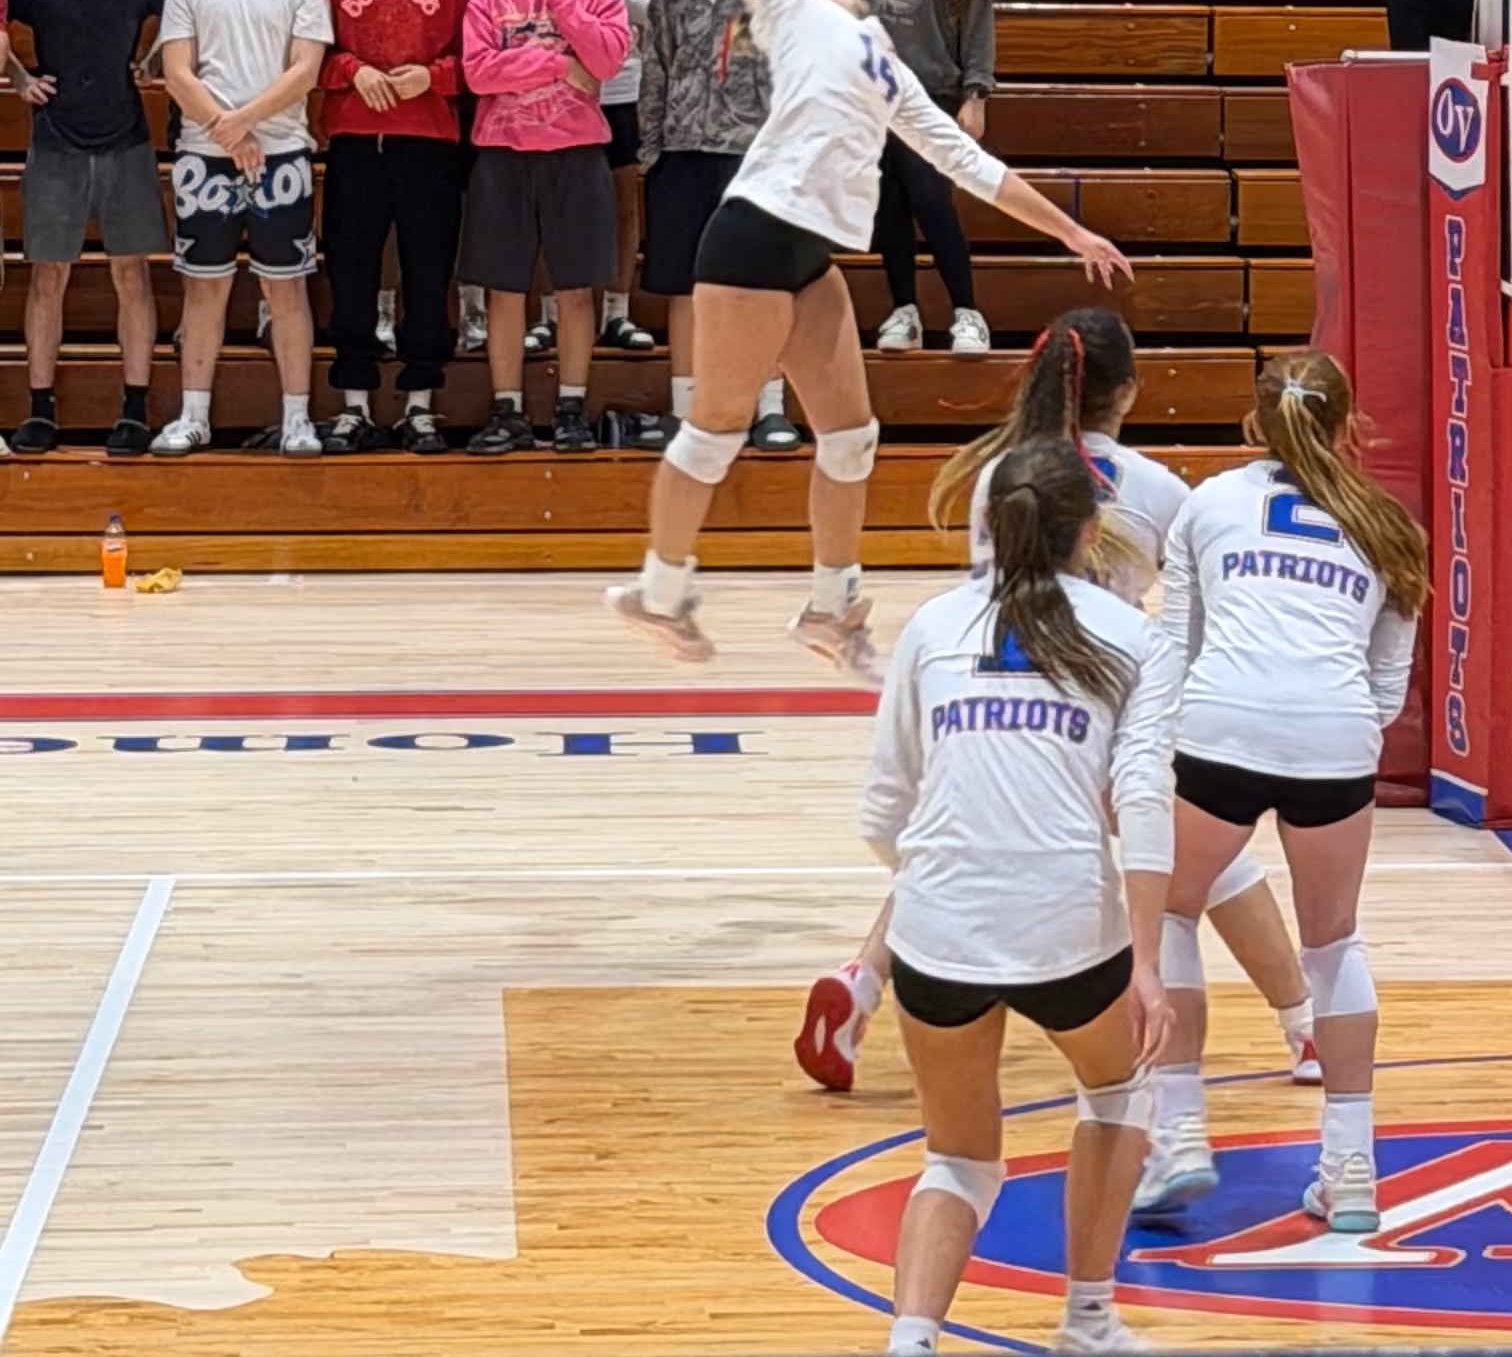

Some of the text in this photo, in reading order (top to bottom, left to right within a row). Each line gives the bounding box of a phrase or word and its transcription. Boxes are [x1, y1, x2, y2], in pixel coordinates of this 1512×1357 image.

[1437, 87, 1475, 155] OV
[1443, 213, 1472, 758] PATRIOTS
[1221, 549, 1370, 604] PATRIOTS
[931, 695, 1092, 744] PATRIOTS
